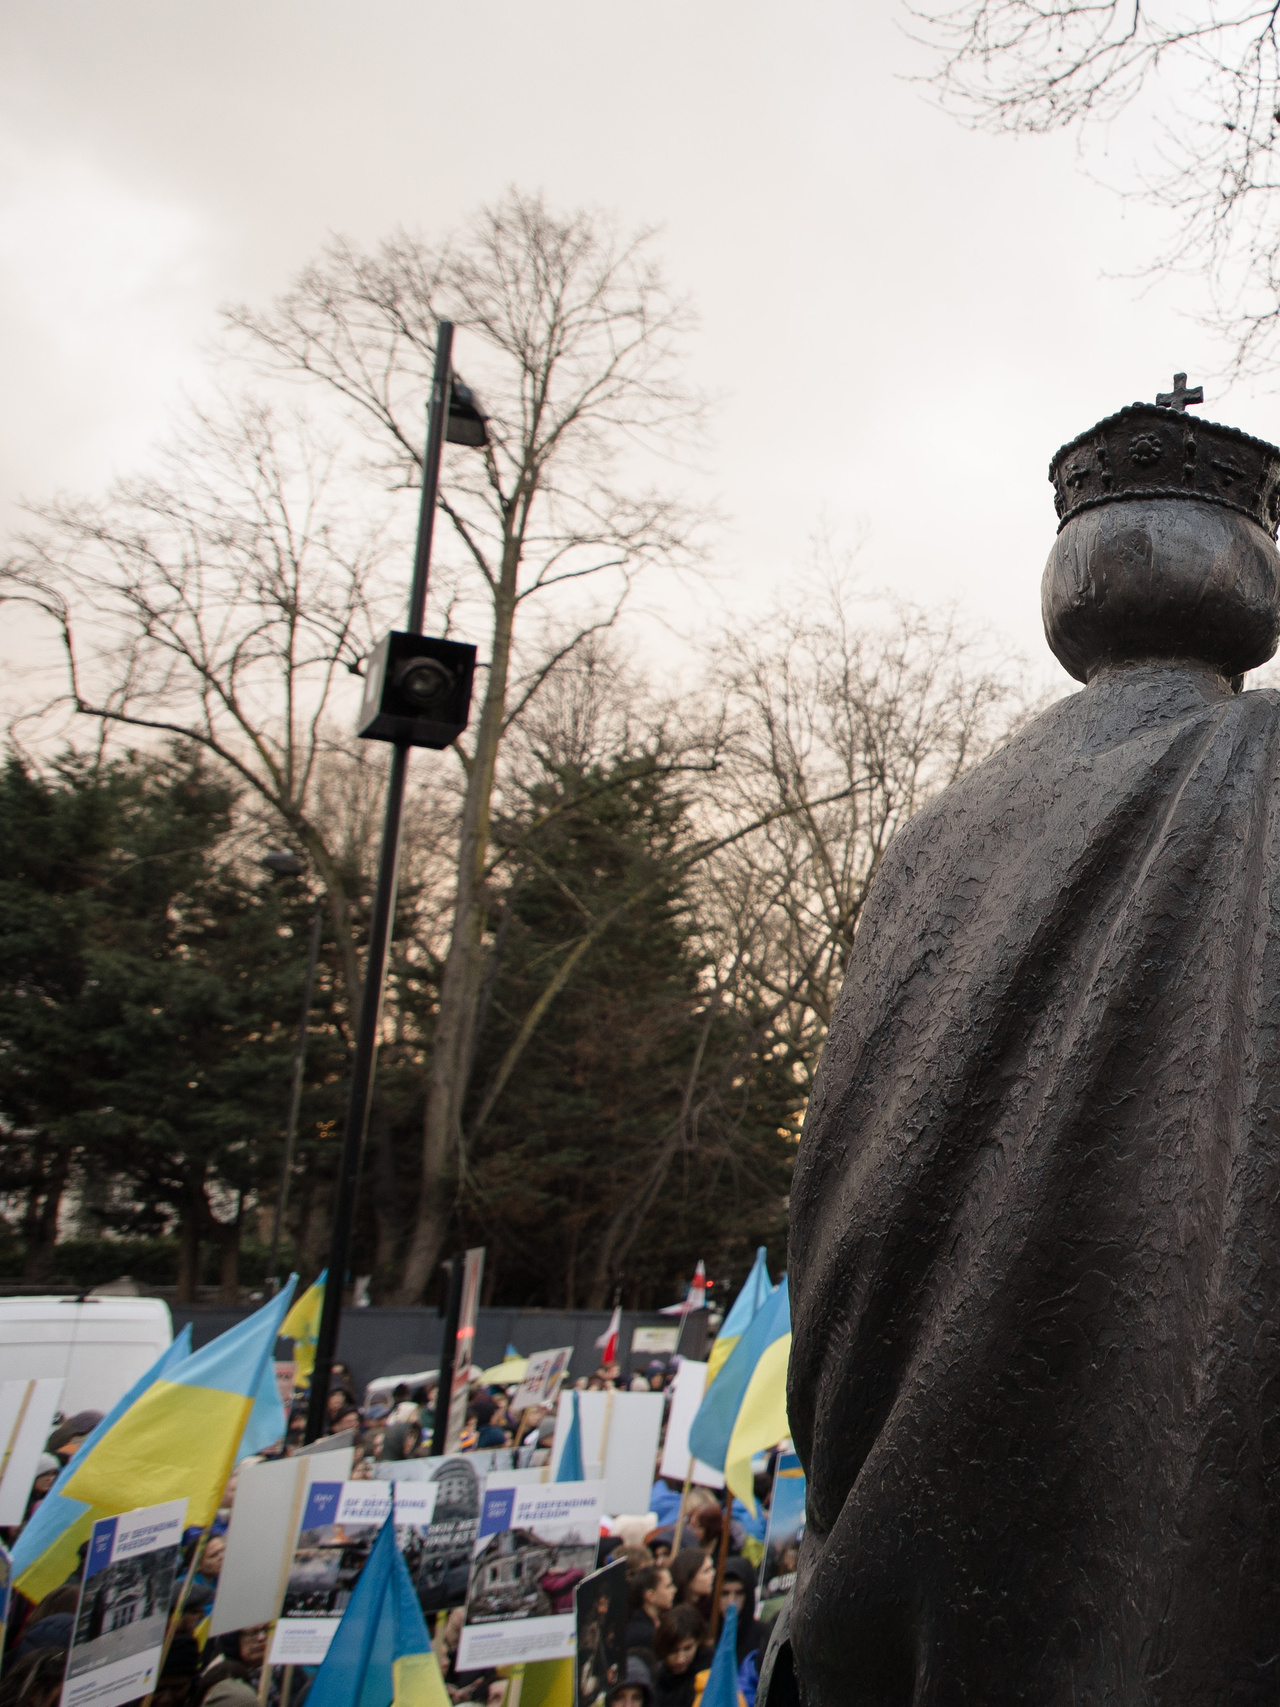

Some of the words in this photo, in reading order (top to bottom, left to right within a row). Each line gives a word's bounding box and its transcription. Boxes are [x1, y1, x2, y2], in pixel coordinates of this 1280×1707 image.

[344, 1499, 360, 1508] OF
[518, 1503, 533, 1512] OF
[535, 1497, 598, 1510] DEFENDING
[342, 1507, 391, 1517] FREEDO
[517, 1509, 570, 1520] FREEDOM
[118, 1531, 130, 1543] OF
[131, 1518, 180, 1539] DEFENDING
[116, 1534, 159, 1552] FREEDOM
